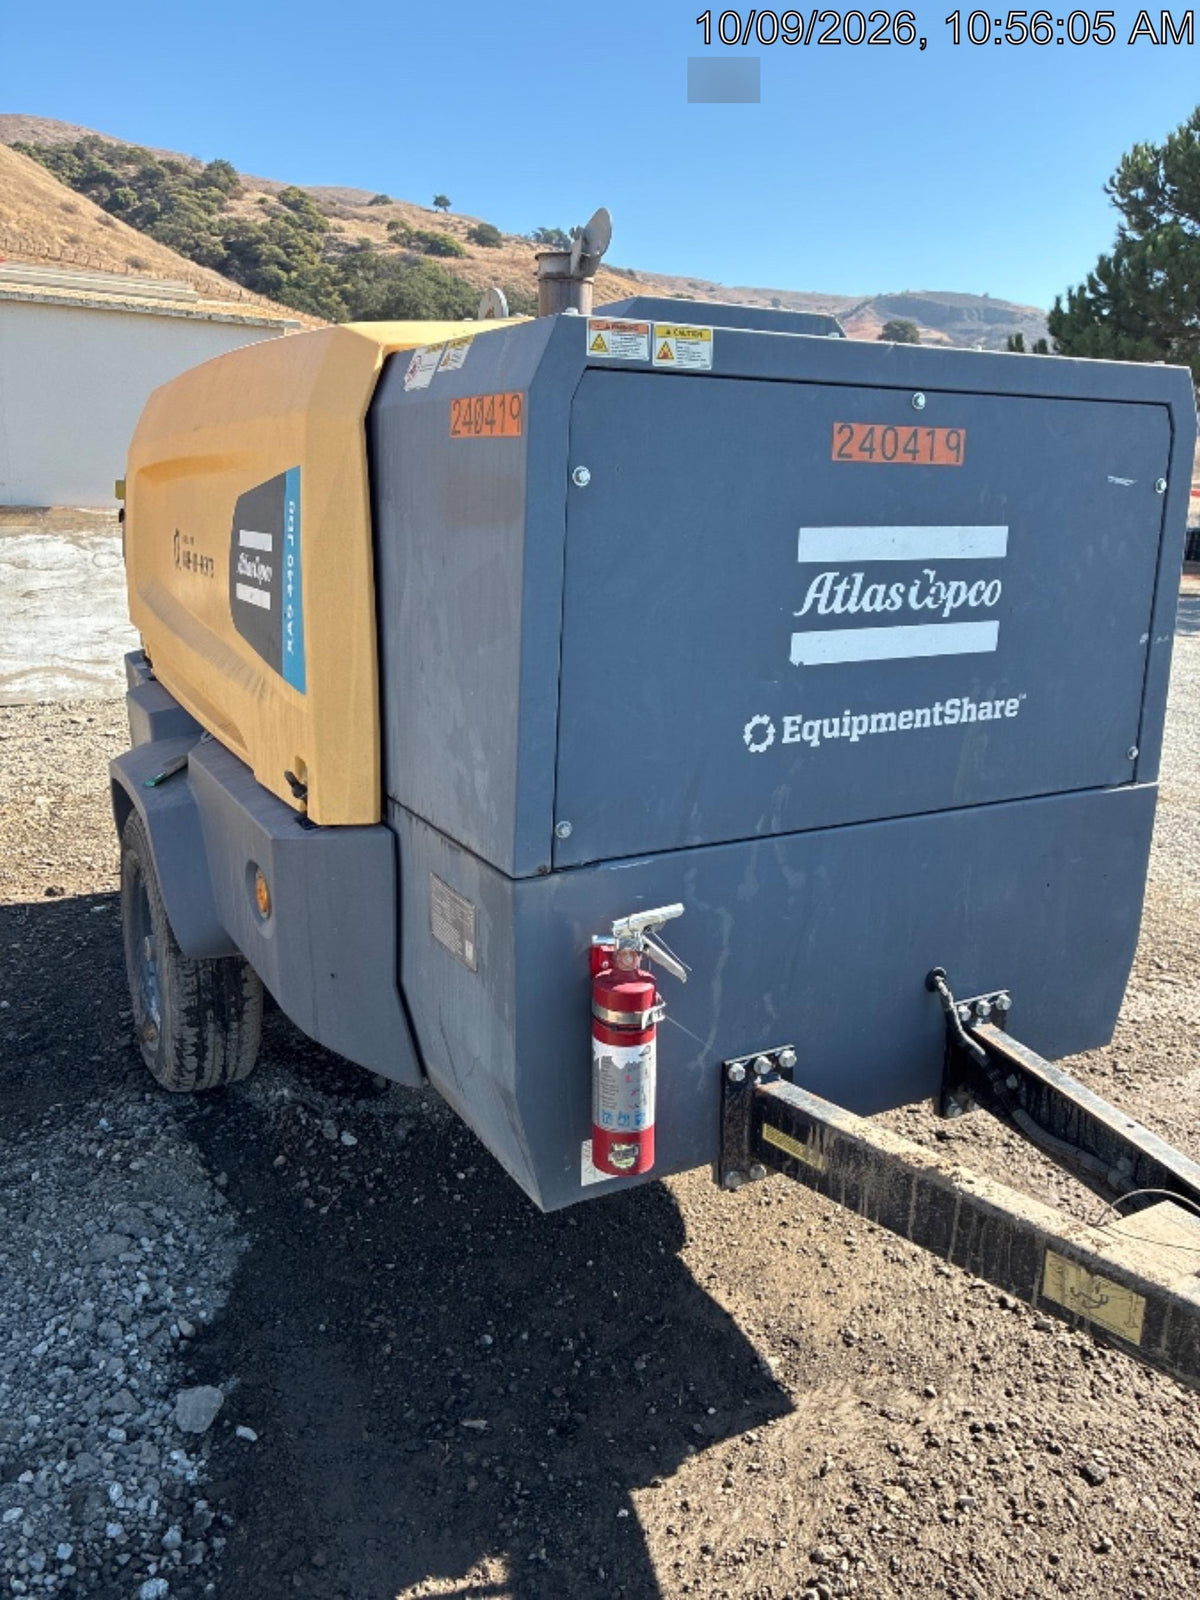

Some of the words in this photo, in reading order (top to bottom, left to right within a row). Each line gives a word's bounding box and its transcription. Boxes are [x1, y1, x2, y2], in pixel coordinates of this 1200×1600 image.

[673, 328, 703, 339] CAUTION
[450, 394, 522, 435] 240419
[836, 424, 962, 463] 240419
[793, 571, 906, 616] Atlas
[781, 696, 1019, 748] EquipmentShare
